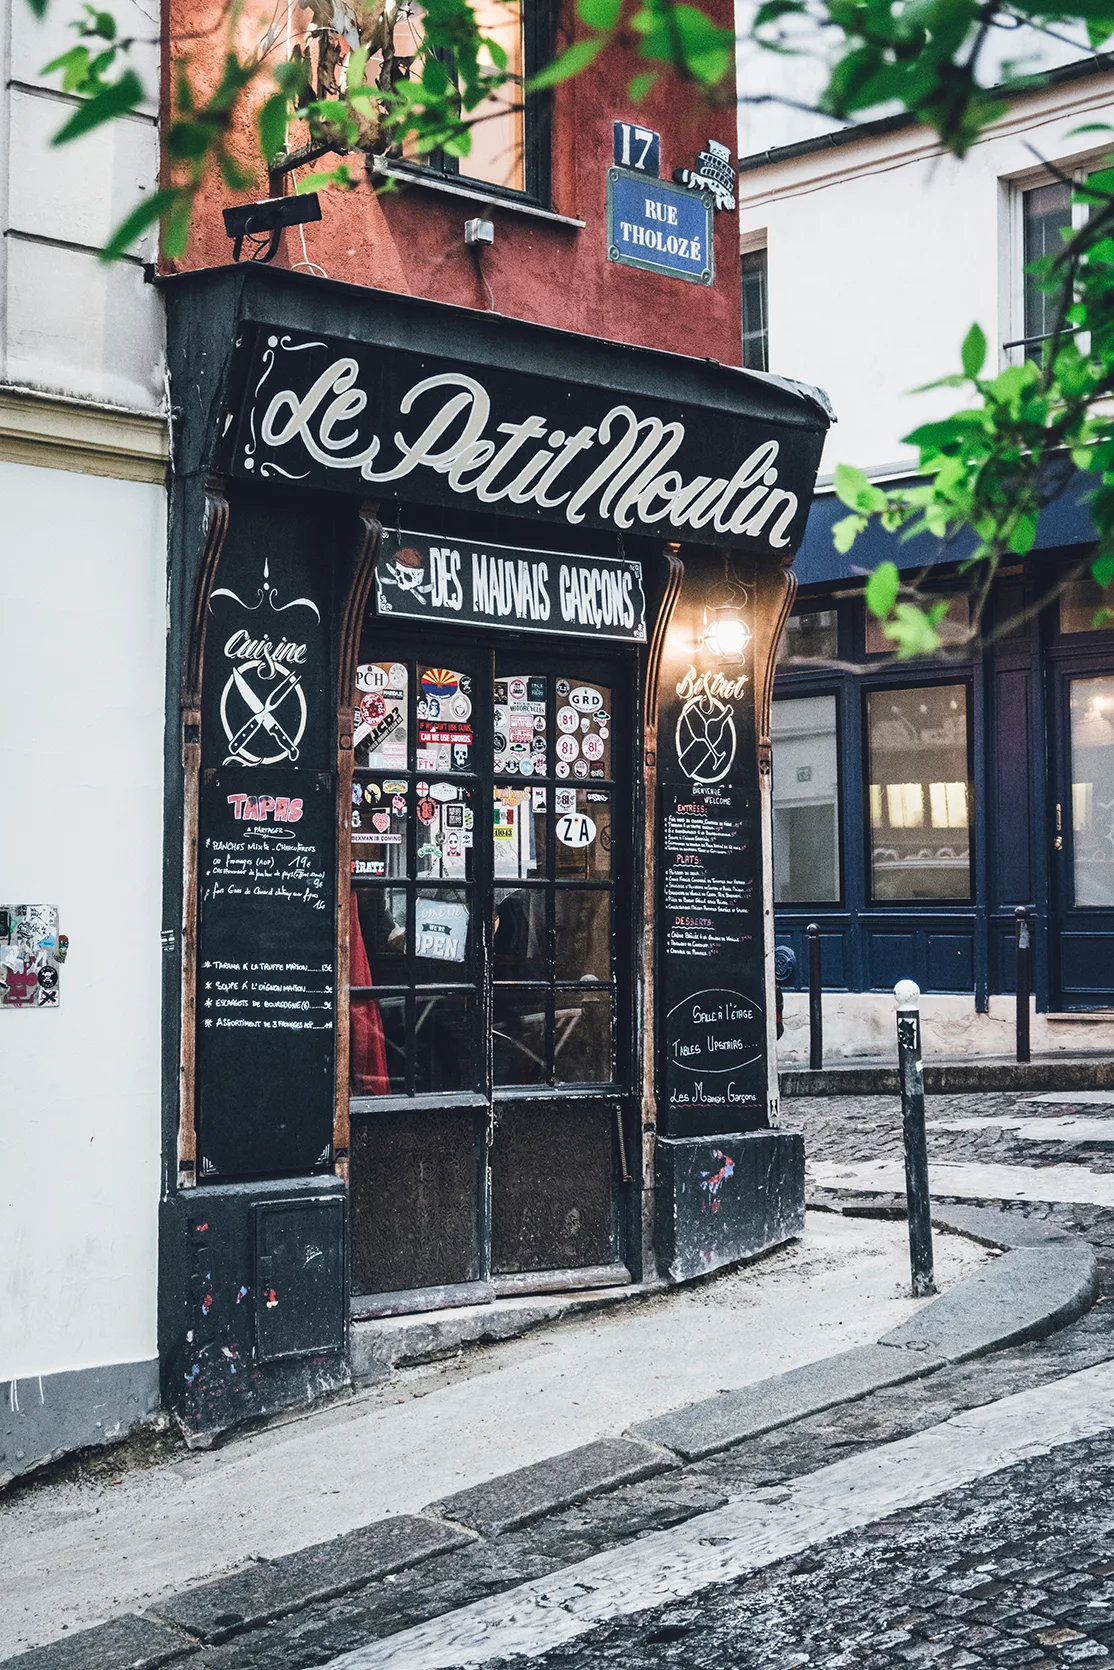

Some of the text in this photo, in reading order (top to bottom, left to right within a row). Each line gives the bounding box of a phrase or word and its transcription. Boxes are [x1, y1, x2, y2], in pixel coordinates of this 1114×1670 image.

[621, 124, 653, 170] 17
[645, 199, 678, 226] RUE
[620, 222, 701, 261] THOLOZÉ
[261, 357, 798, 549] Le Petit Moulin
[430, 548, 635, 630] DES MAUVAIS GARÇONS
[224, 629, 307, 680] Cuisine
[356, 671, 384, 686] PCH
[676, 664, 749, 715] Bistrot
[572, 695, 600, 705] GRD
[562, 715, 573, 725] 81
[562, 742, 573, 754] 81
[588, 742, 597, 752] 81
[227, 793, 304, 823] TAPAS
[672, 1038, 701, 1057] TABLES
[670, 1088, 690, 1103] Les
